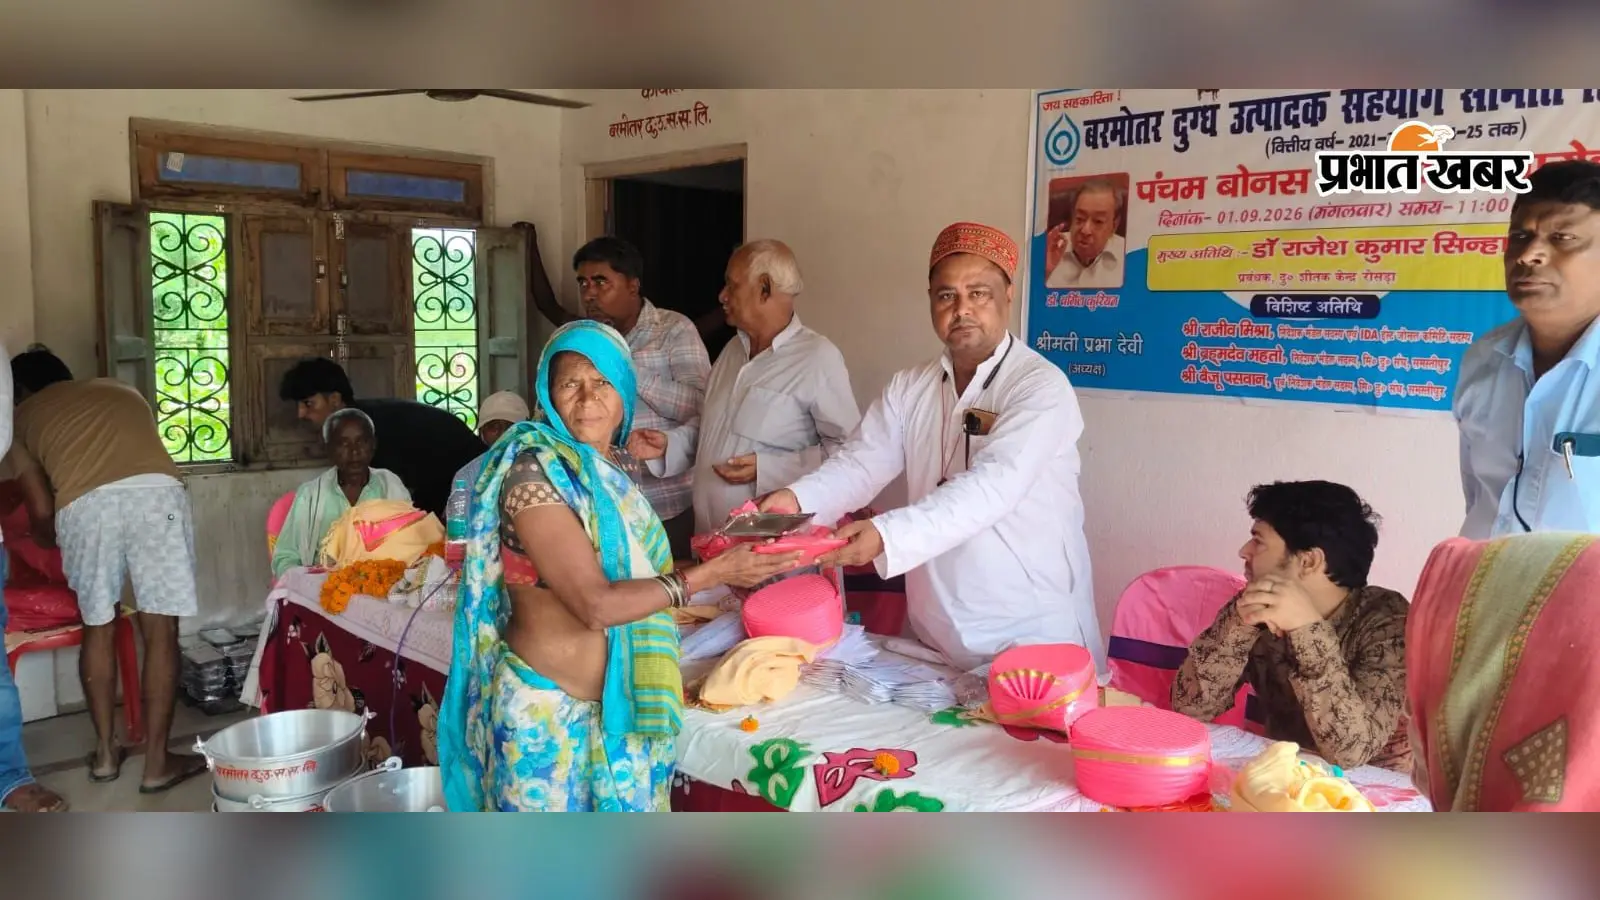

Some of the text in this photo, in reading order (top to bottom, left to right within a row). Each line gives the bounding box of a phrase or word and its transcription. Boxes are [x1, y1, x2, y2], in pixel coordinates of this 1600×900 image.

[1042, 100, 1061, 111] जय
[1063, 90, 1114, 109] सहकारिता
[608, 112, 645, 138] बरमोतर
[1083, 106, 1164, 150] बरमोतर
[1172, 104, 1221, 153] दुग्ध
[1229, 91, 1331, 135] उत्पादक
[1265, 135, 1312, 159] (वित्तीय
[1488, 115, 1527, 141] तक)
[1136, 164, 1312, 203] पंचम बोनस
[1217, 207, 1303, 225] 01.09.2026
[1308, 200, 1392, 221] (मंगलवार)
[1156, 248, 1186, 264] मुख्य
[1189, 245, 1235, 260] अतिथि
[1251, 237, 1279, 260] डॉ
[1281, 235, 1350, 257] राजेश
[1354, 237, 1428, 264] कुमार
[1433, 230, 1509, 255] सिन्हा
[1299, 269, 1331, 283] शीतक
[1335, 269, 1357, 283] केन्द्र
[1265, 296, 1363, 315] विशिष्ट अतिथि
[1182, 317, 1198, 337] श्री
[1200, 317, 1237, 337] राजीव
[1239, 317, 1274, 340] मिश्रा,
[1360, 328, 1379, 341] IDA
[1036, 330, 1143, 354] श्रीमती प्रभा देवी
[1181, 341, 1198, 360] श्री
[1247, 343, 1287, 365] महतो,
[1068, 362, 1106, 376] (अध्यक्ष)
[1180, 364, 1197, 384] श्री
[1222, 371, 1271, 388] पसवान,
